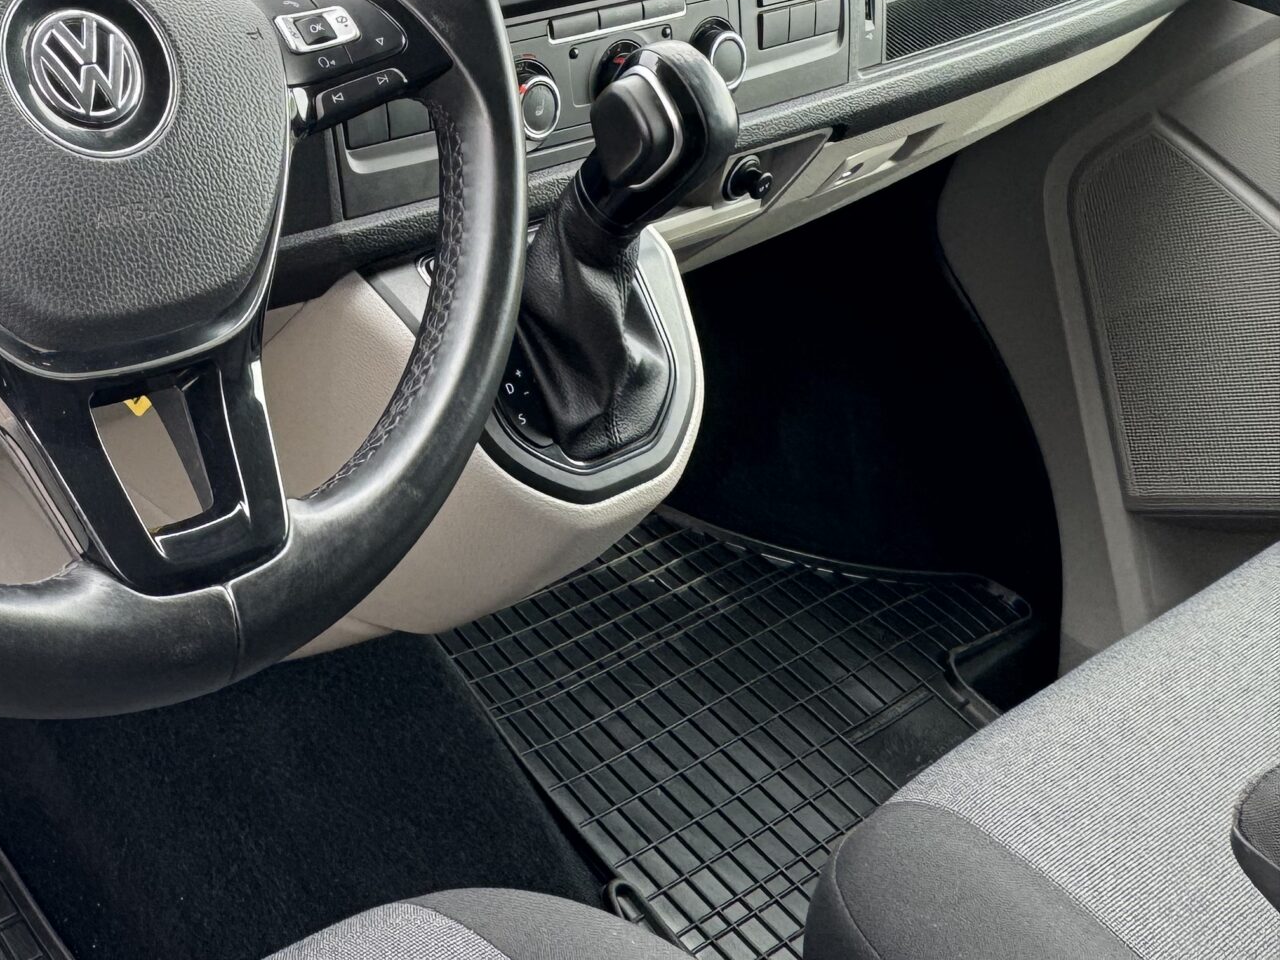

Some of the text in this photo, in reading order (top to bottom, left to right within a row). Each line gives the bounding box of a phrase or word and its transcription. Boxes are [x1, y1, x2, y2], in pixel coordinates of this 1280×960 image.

[309, 22, 325, 33] OK
[504, 382, 515, 395] D
[518, 413, 527, 425] S
